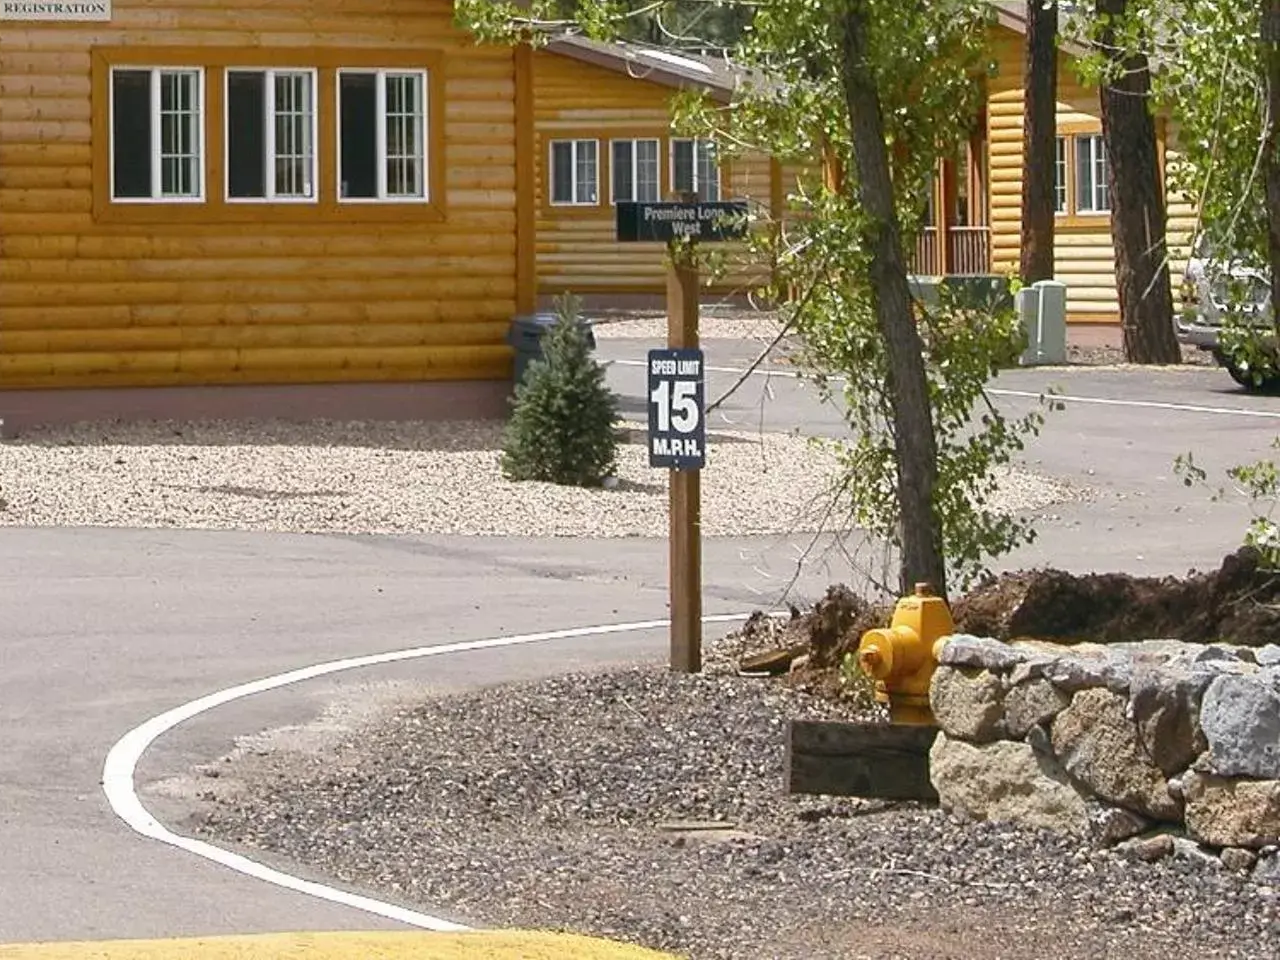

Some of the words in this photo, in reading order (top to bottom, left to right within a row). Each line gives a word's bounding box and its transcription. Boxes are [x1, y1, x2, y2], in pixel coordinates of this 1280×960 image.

[4, 2, 105, 14] REGISTRATION
[644, 205, 695, 220] Premiere
[672, 221, 701, 235] West
[651, 359, 676, 376] SPEED
[677, 359, 701, 375] LIMIT
[651, 380, 699, 434] 15
